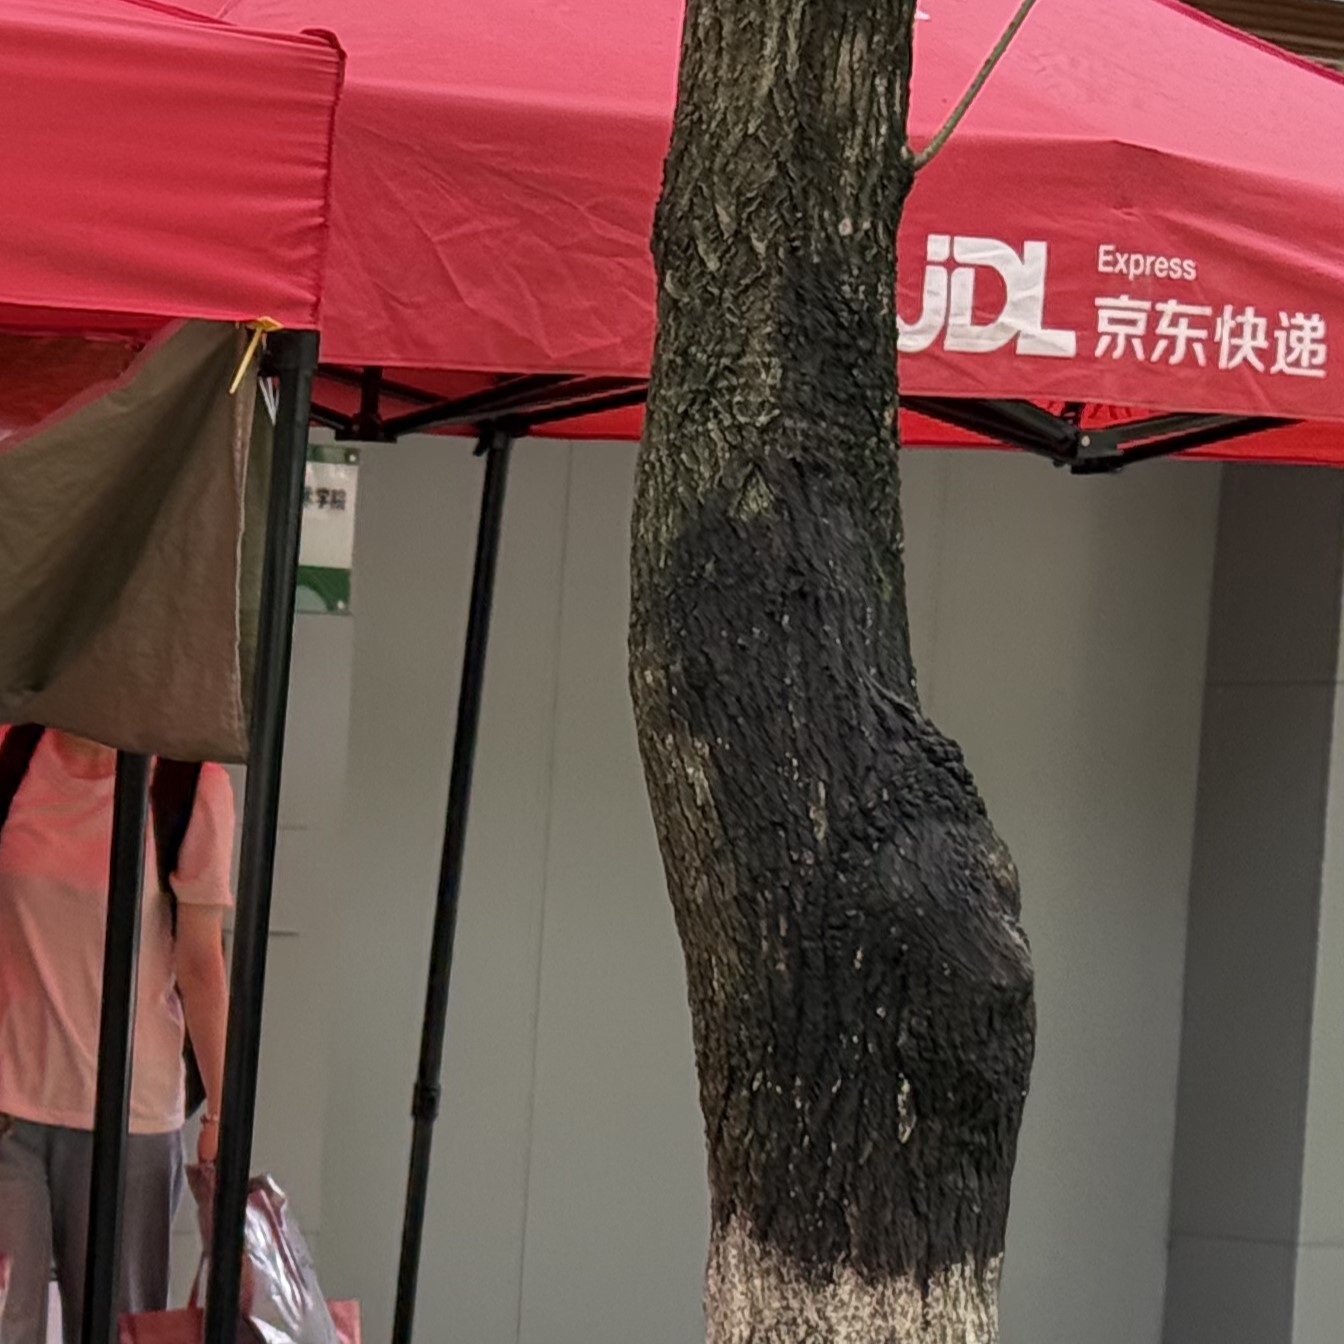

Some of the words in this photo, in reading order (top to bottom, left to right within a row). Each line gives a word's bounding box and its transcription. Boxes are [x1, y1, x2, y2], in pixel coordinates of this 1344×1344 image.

[898, 234, 1077, 358] JDL
[1098, 244, 1197, 282] Express
[1093, 296, 1328, 379] 京东快递
